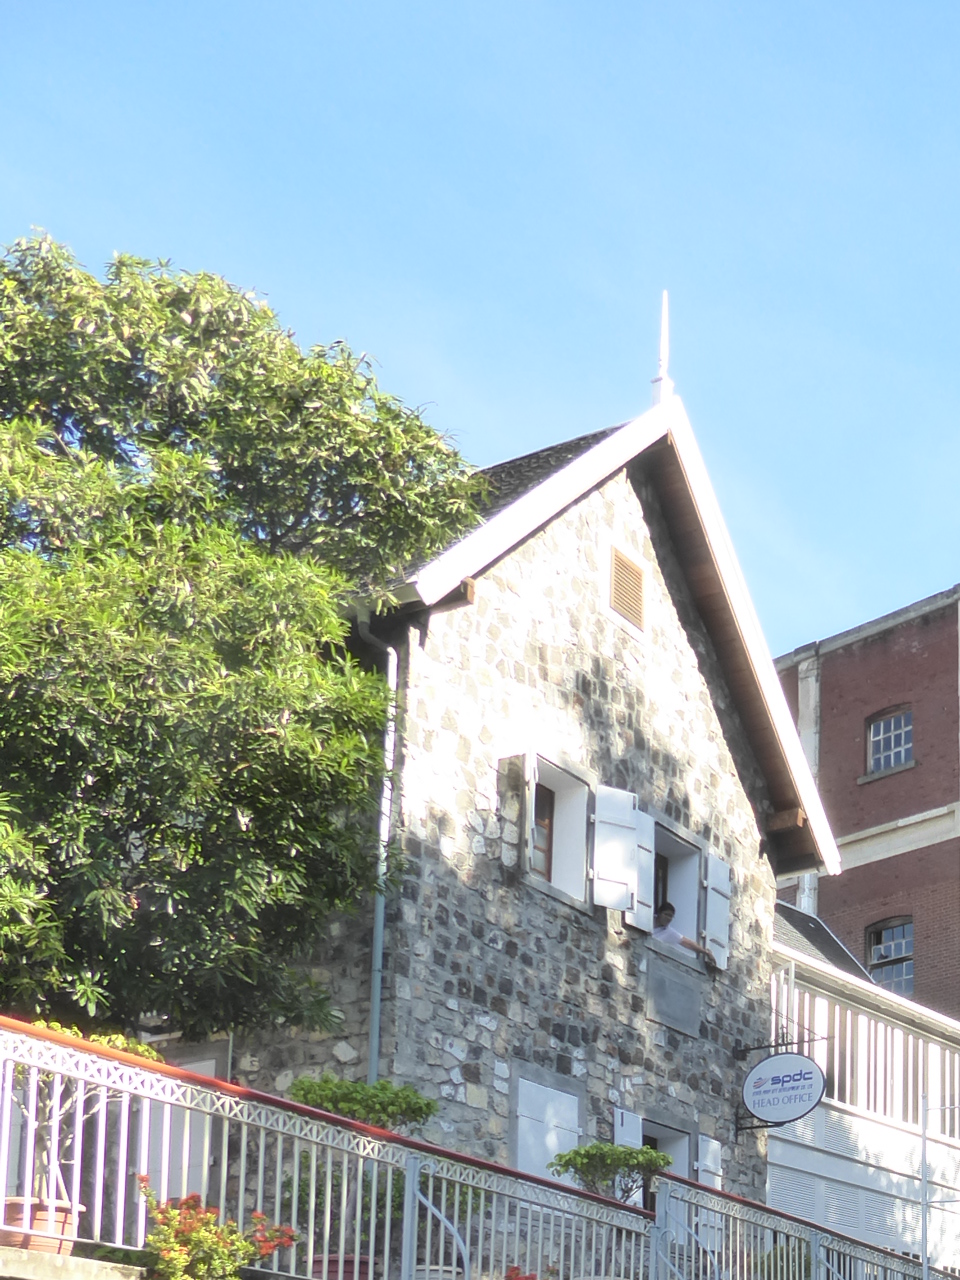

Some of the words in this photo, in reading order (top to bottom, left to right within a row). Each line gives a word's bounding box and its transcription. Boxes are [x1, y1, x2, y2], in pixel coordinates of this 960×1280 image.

[771, 1070, 813, 1087] spdc
[753, 1097, 779, 1109] HEAD
[782, 1093, 812, 1104] OFFICE
